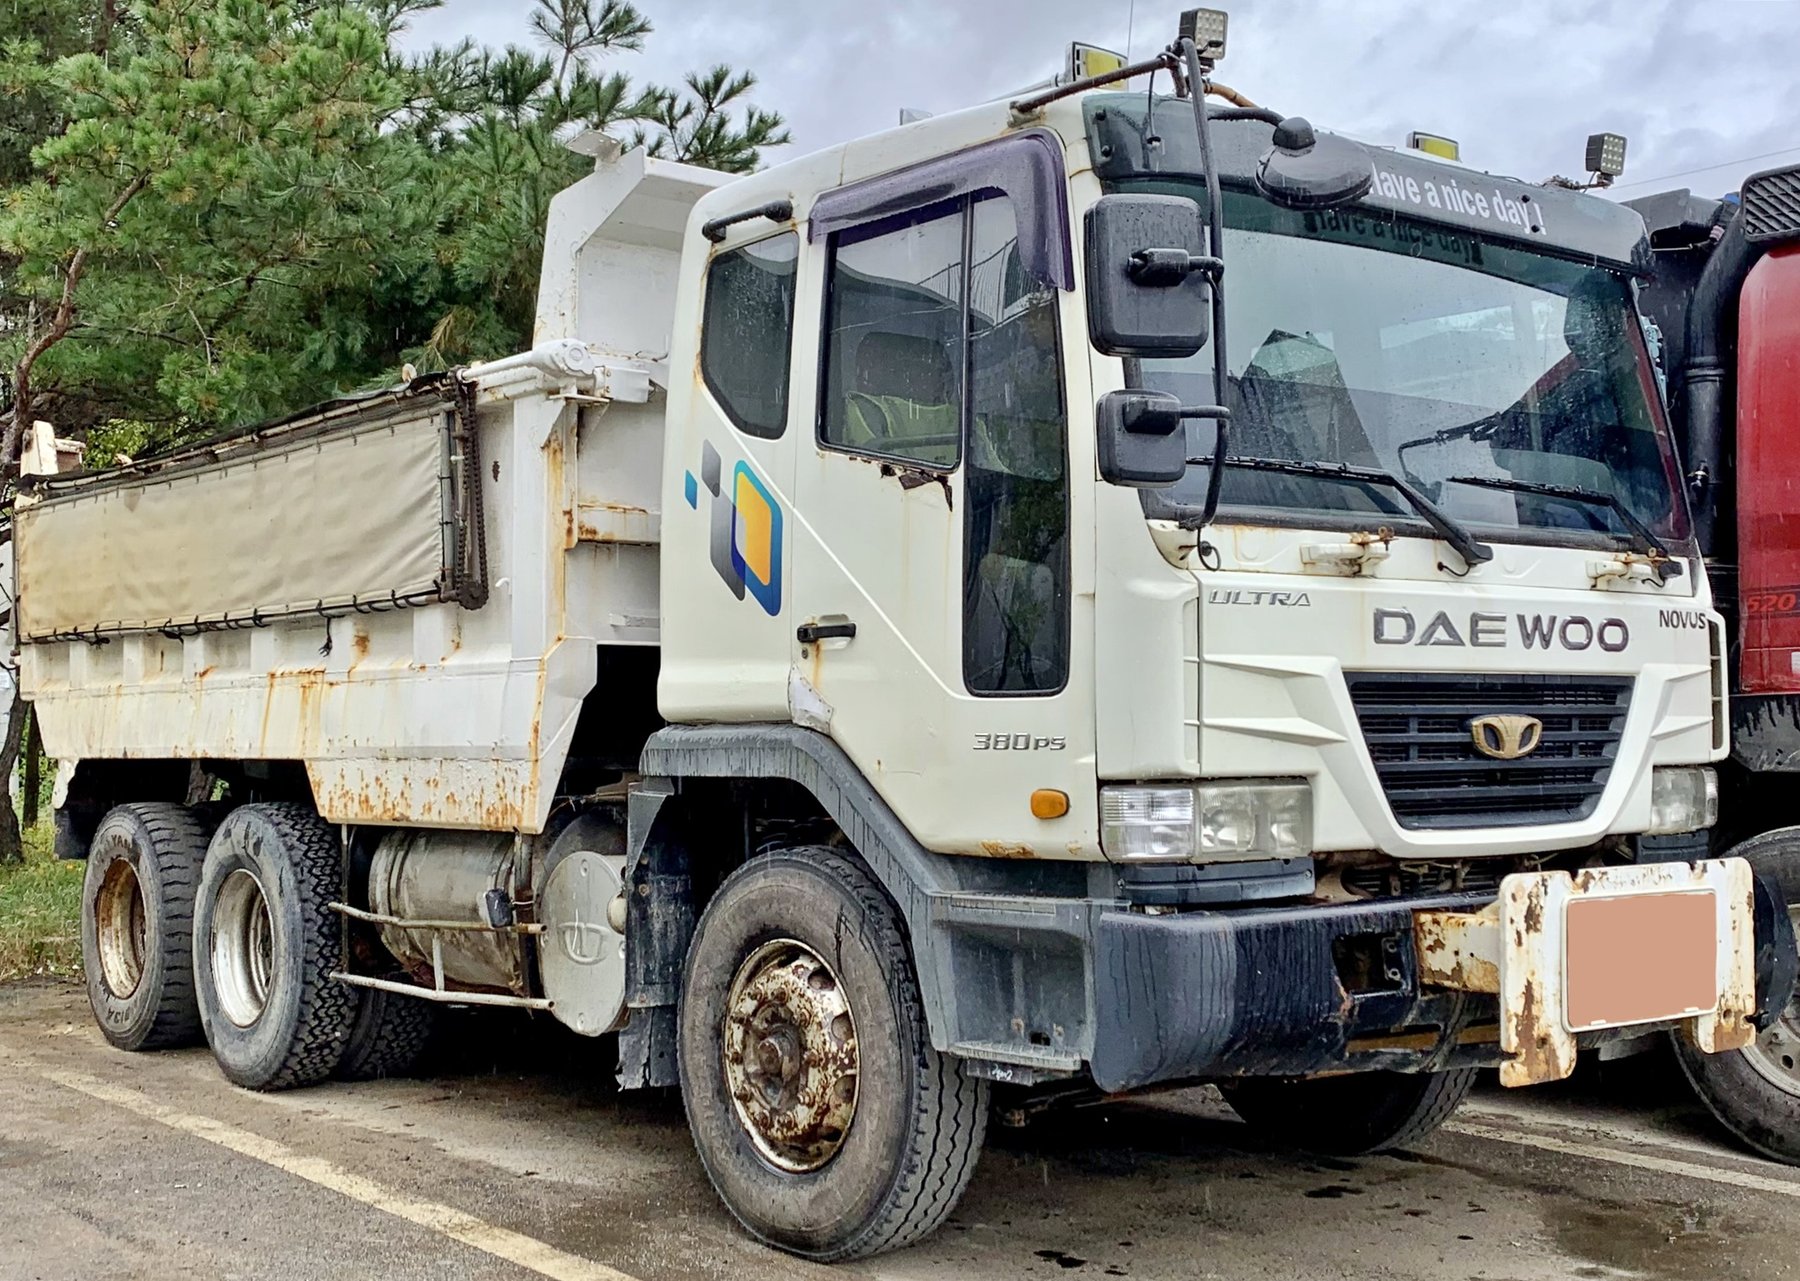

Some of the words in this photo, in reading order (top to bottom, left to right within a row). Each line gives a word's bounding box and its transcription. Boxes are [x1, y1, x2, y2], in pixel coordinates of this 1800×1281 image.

[1424, 180, 1442, 209] a
[1441, 178, 1491, 219] nice
[1208, 589, 1311, 607] ULTRA
[1373, 606, 1630, 653] DAEWOO
[1658, 609, 1707, 630] NOVUS
